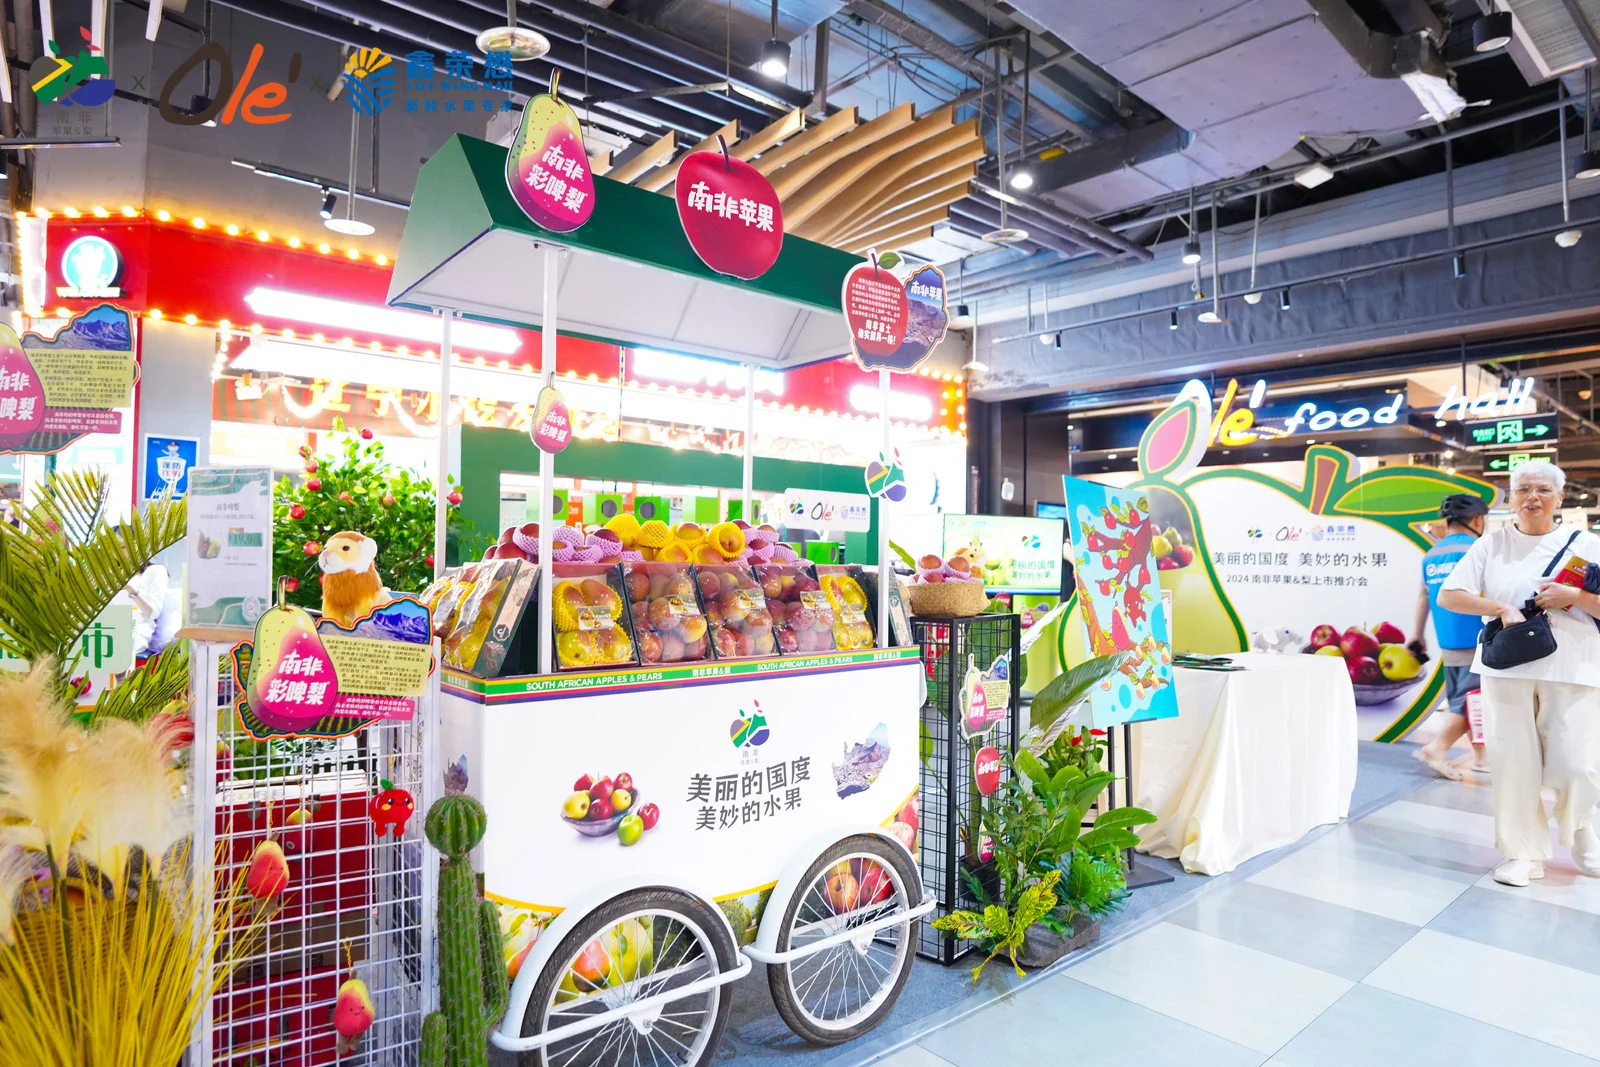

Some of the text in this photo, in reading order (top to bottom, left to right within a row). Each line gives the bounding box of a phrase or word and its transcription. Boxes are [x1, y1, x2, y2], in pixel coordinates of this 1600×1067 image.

[541, 144, 585, 181] 南非
[525, 163, 587, 214] 彩啤梨
[687, 180, 774, 232] 南非苹果
[911, 280, 943, 301] 南非苹果
[1284, 394, 1404, 434] food
[1434, 377, 1536, 421] hall
[546, 410, 567, 427] 南非
[539, 423, 569, 443] 彩啤梨
[1010, 559, 1055, 570] 美丽的国度
[1213, 552, 1388, 567] 美丽的国度 美妙的水果
[1226, 573, 1369, 587] 2024 南非苹果&梨上市推介会
[278, 648, 323, 677] 南非
[757, 662, 778, 671] SOUTH
[779, 660, 805, 669] AFRICAN
[806, 658, 827, 667] APPLES
[834, 655, 853, 664] PEARS
[264, 678, 330, 706] 彩啤梨
[526, 672, 663, 691] SOUTH AFRICAN APPLES & PEARS
[686, 756, 811, 803] 美丽的国度
[695, 787, 802, 831] 美妙的水果
